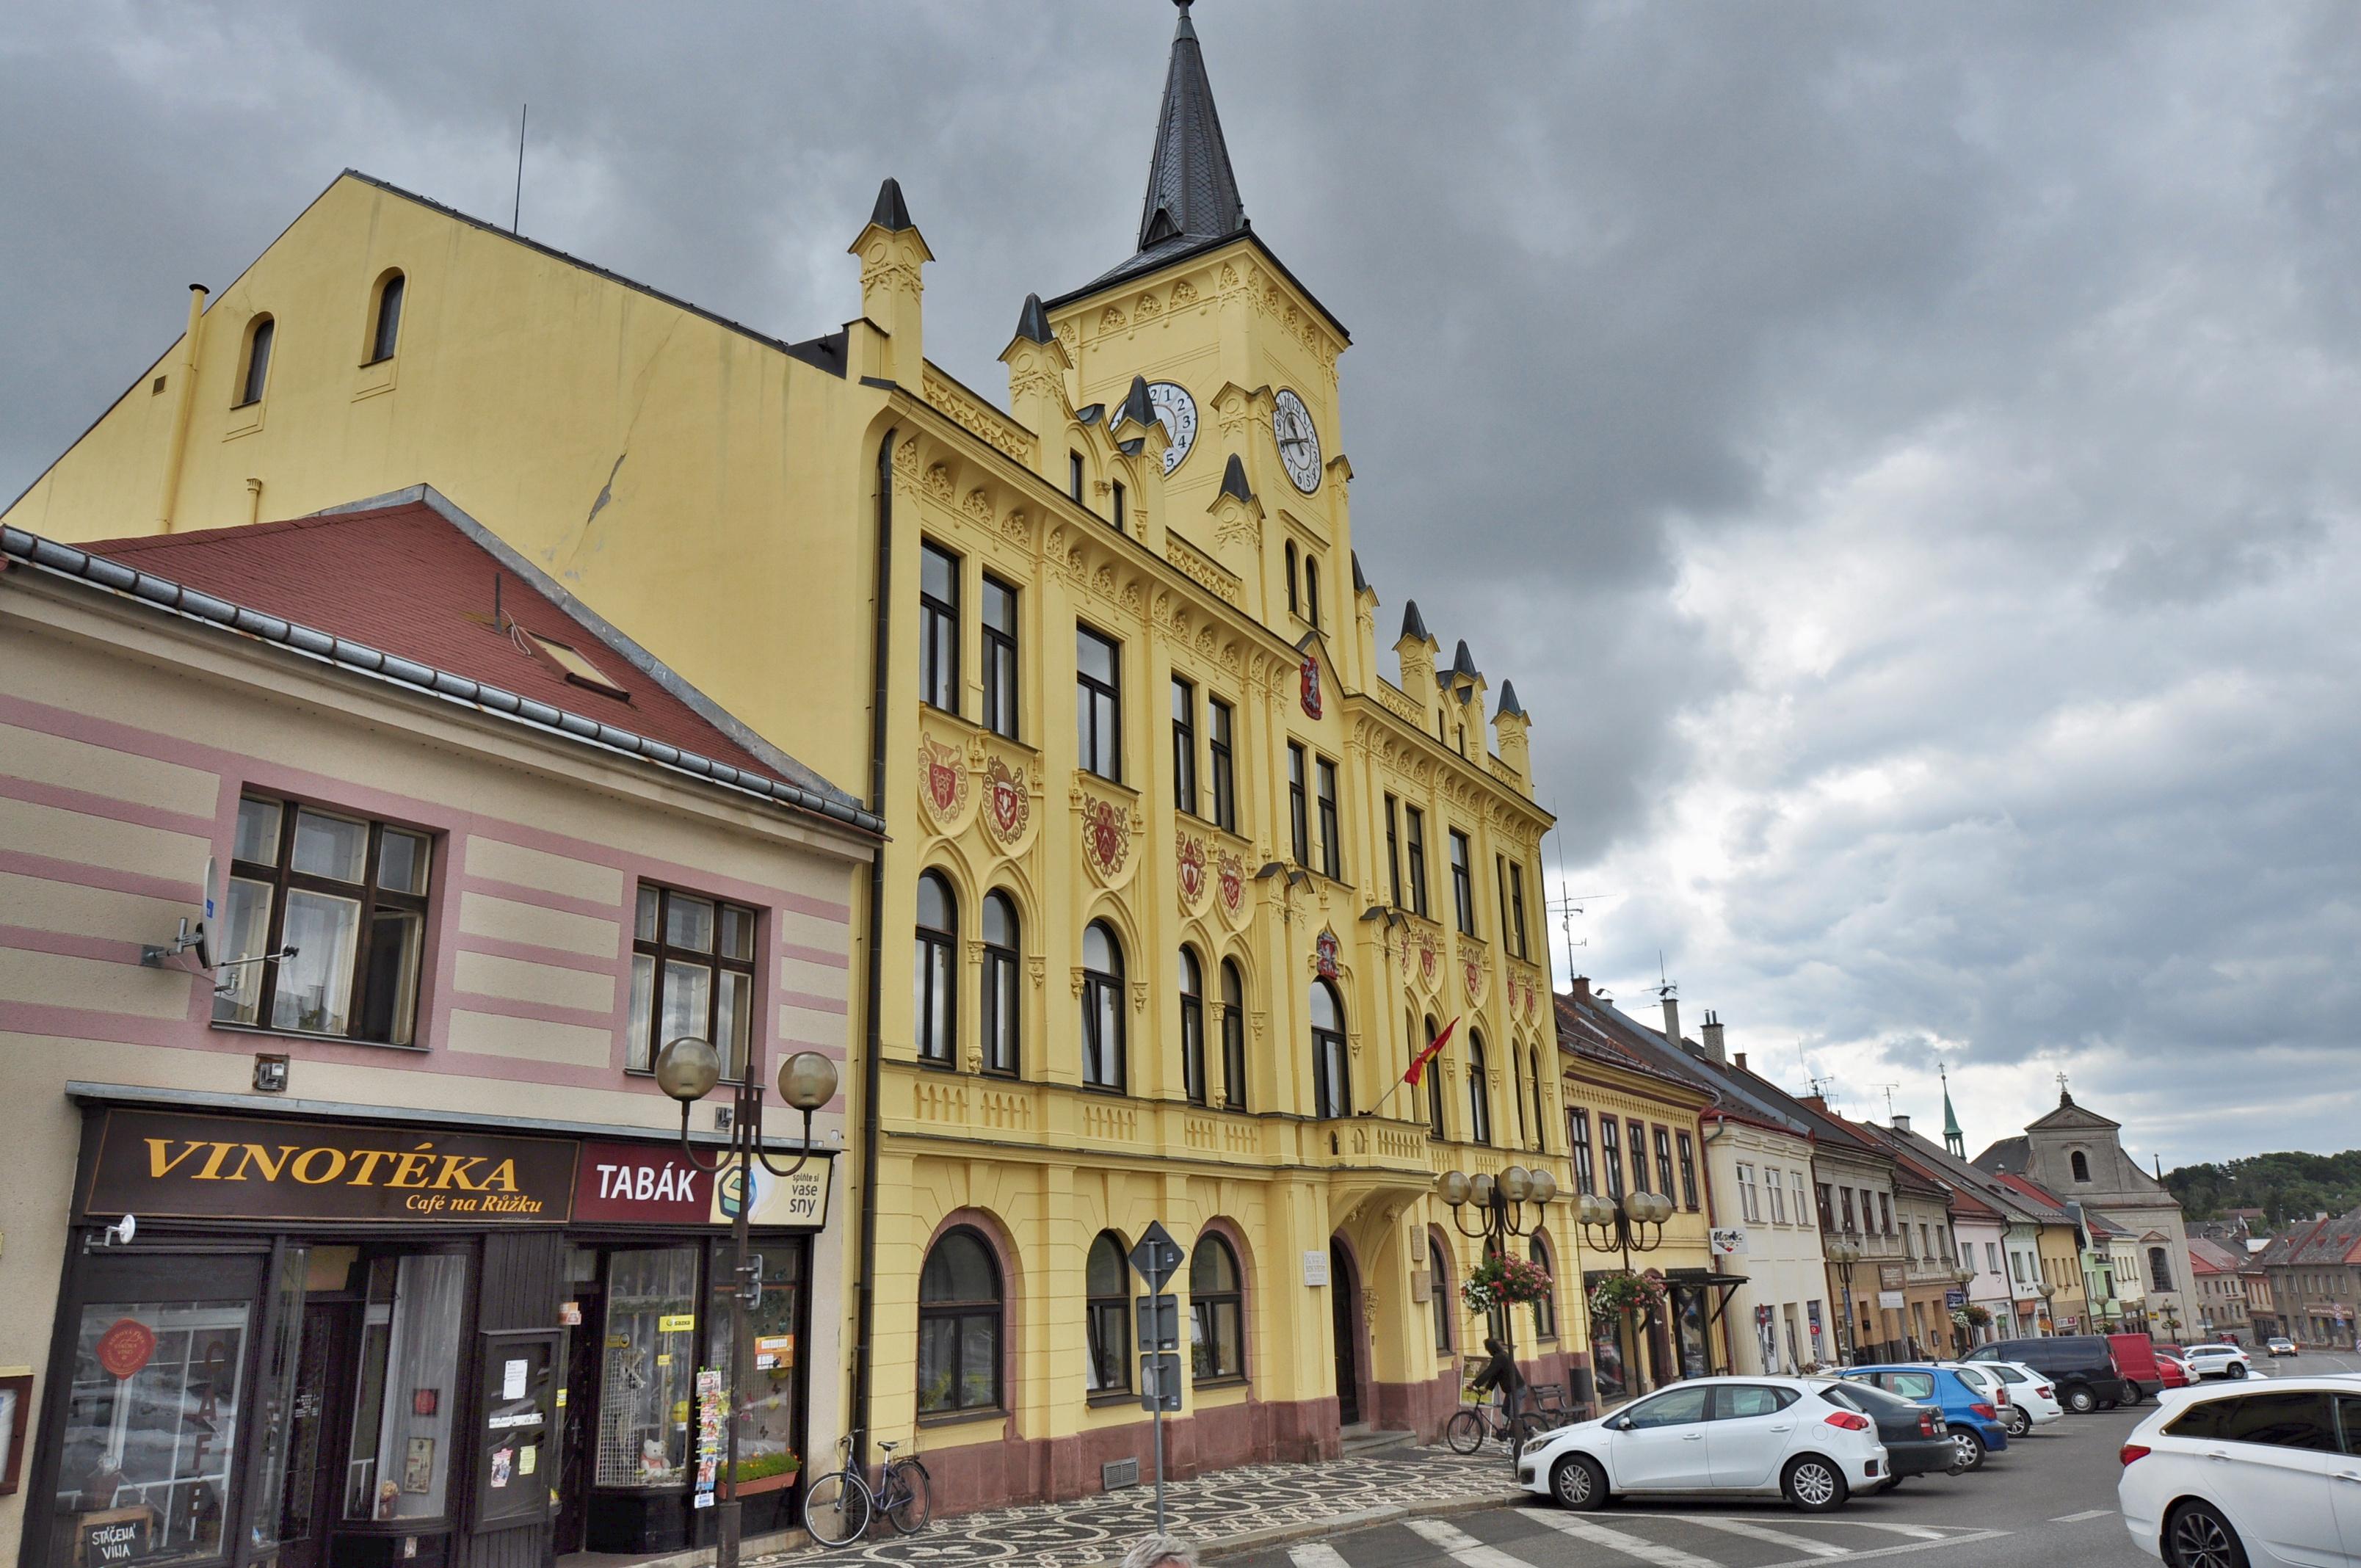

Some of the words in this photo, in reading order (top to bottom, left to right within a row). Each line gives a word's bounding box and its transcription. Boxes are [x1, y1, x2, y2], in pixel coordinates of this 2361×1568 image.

[1164, 388, 1172, 402] 1
[1177, 398, 1186, 411] 2
[1283, 395, 1291, 412] 11
[1291, 397, 1300, 415] 12
[1182, 415, 1191, 429] 3
[1276, 418, 1282, 432] 9
[1178, 435, 1187, 449] 4
[1310, 431, 1315, 444] 2
[1280, 440, 1285, 454] 8
[1166, 453, 1175, 467] 5
[1288, 457, 1293, 471] 7
[1313, 451, 1319, 464] 3
[1297, 471, 1302, 484] 6
[1306, 474, 1311, 487] 5
[1311, 468, 1316, 481] 4
[144, 1138, 519, 1192] VINOTÉKA
[597, 1161, 697, 1202] TABÁK
[406, 1195, 446, 1215] Café
[450, 1198, 477, 1211] na
[479, 1194, 544, 1213] Růžku
[789, 1198, 816, 1219] sny
